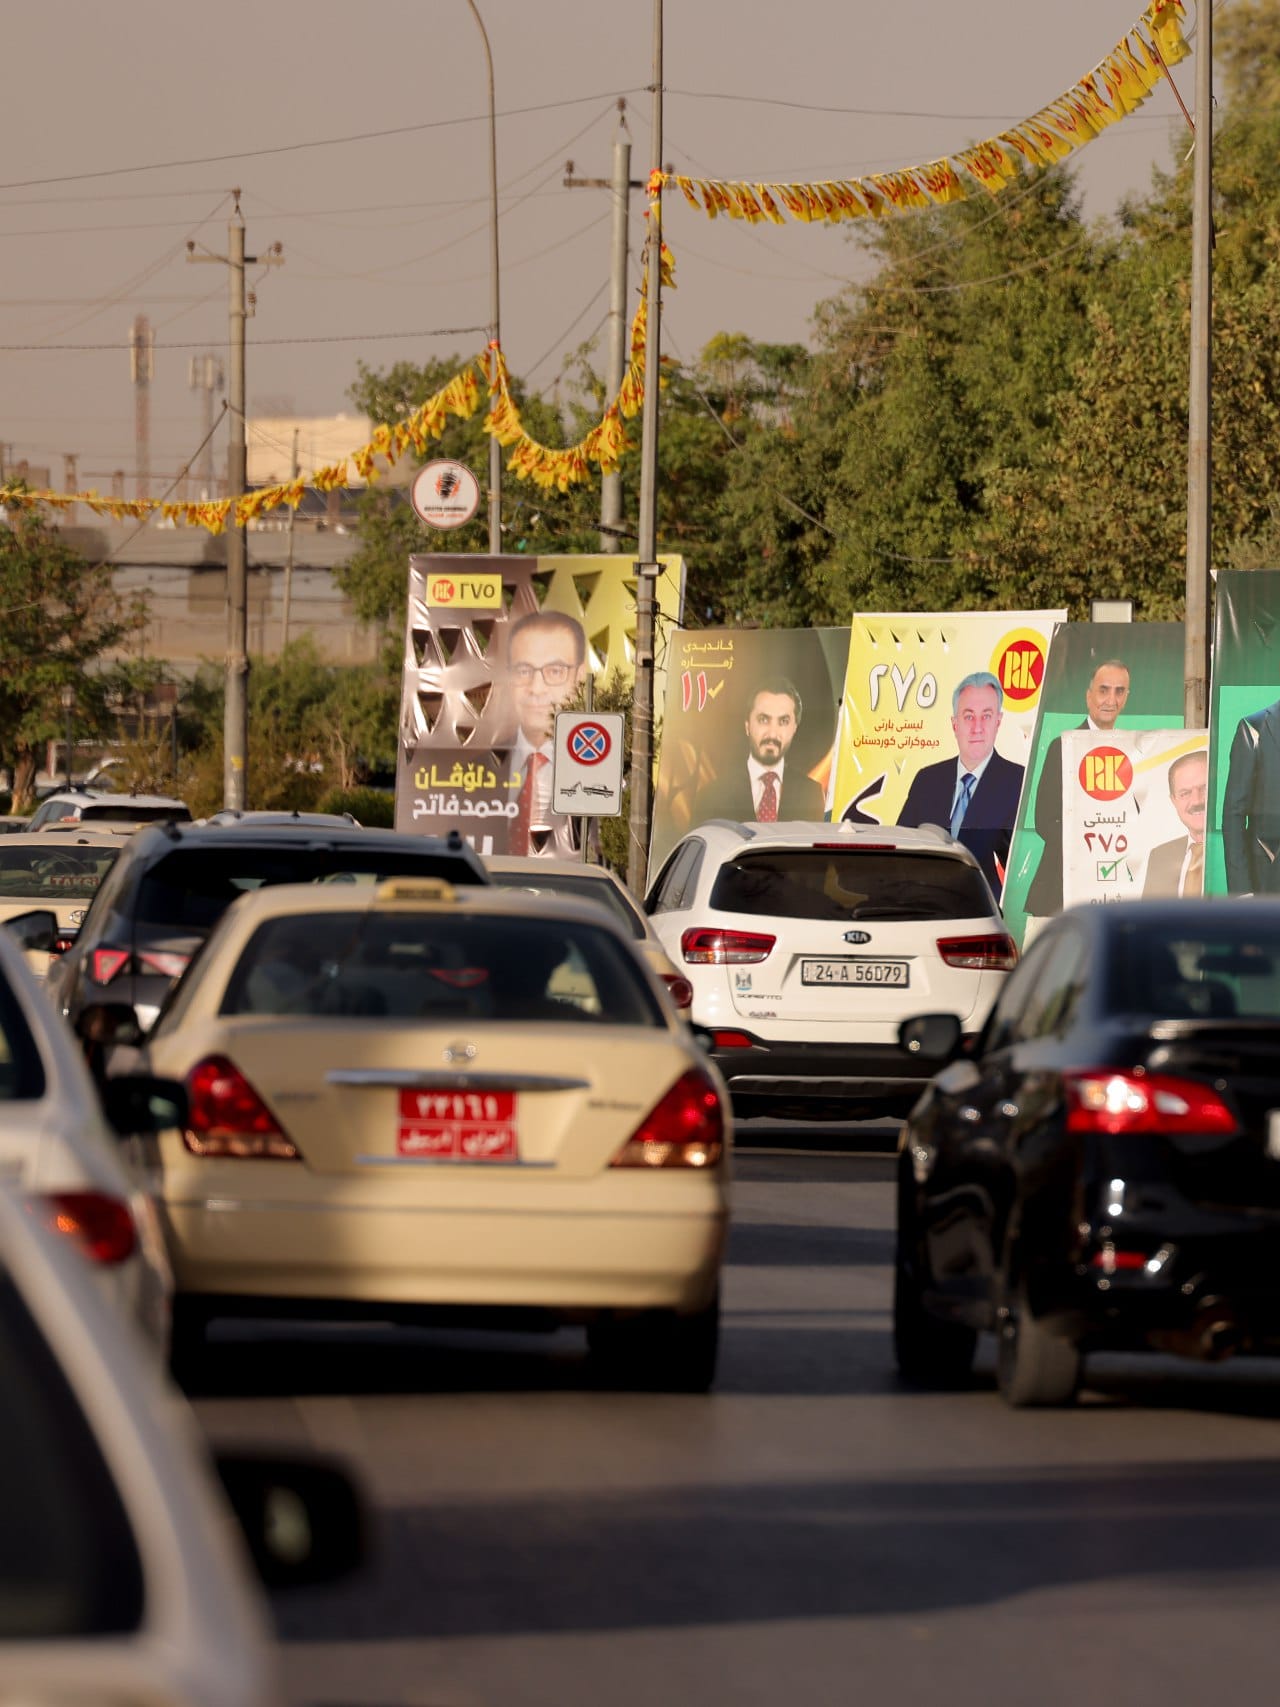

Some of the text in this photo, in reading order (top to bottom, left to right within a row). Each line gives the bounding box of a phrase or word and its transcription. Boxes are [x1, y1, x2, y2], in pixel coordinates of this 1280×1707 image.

[868, 662, 938, 712] ٢٧٥
[1083, 832, 1128, 853] ٢٧٥
[847, 932, 868, 942] KIA
